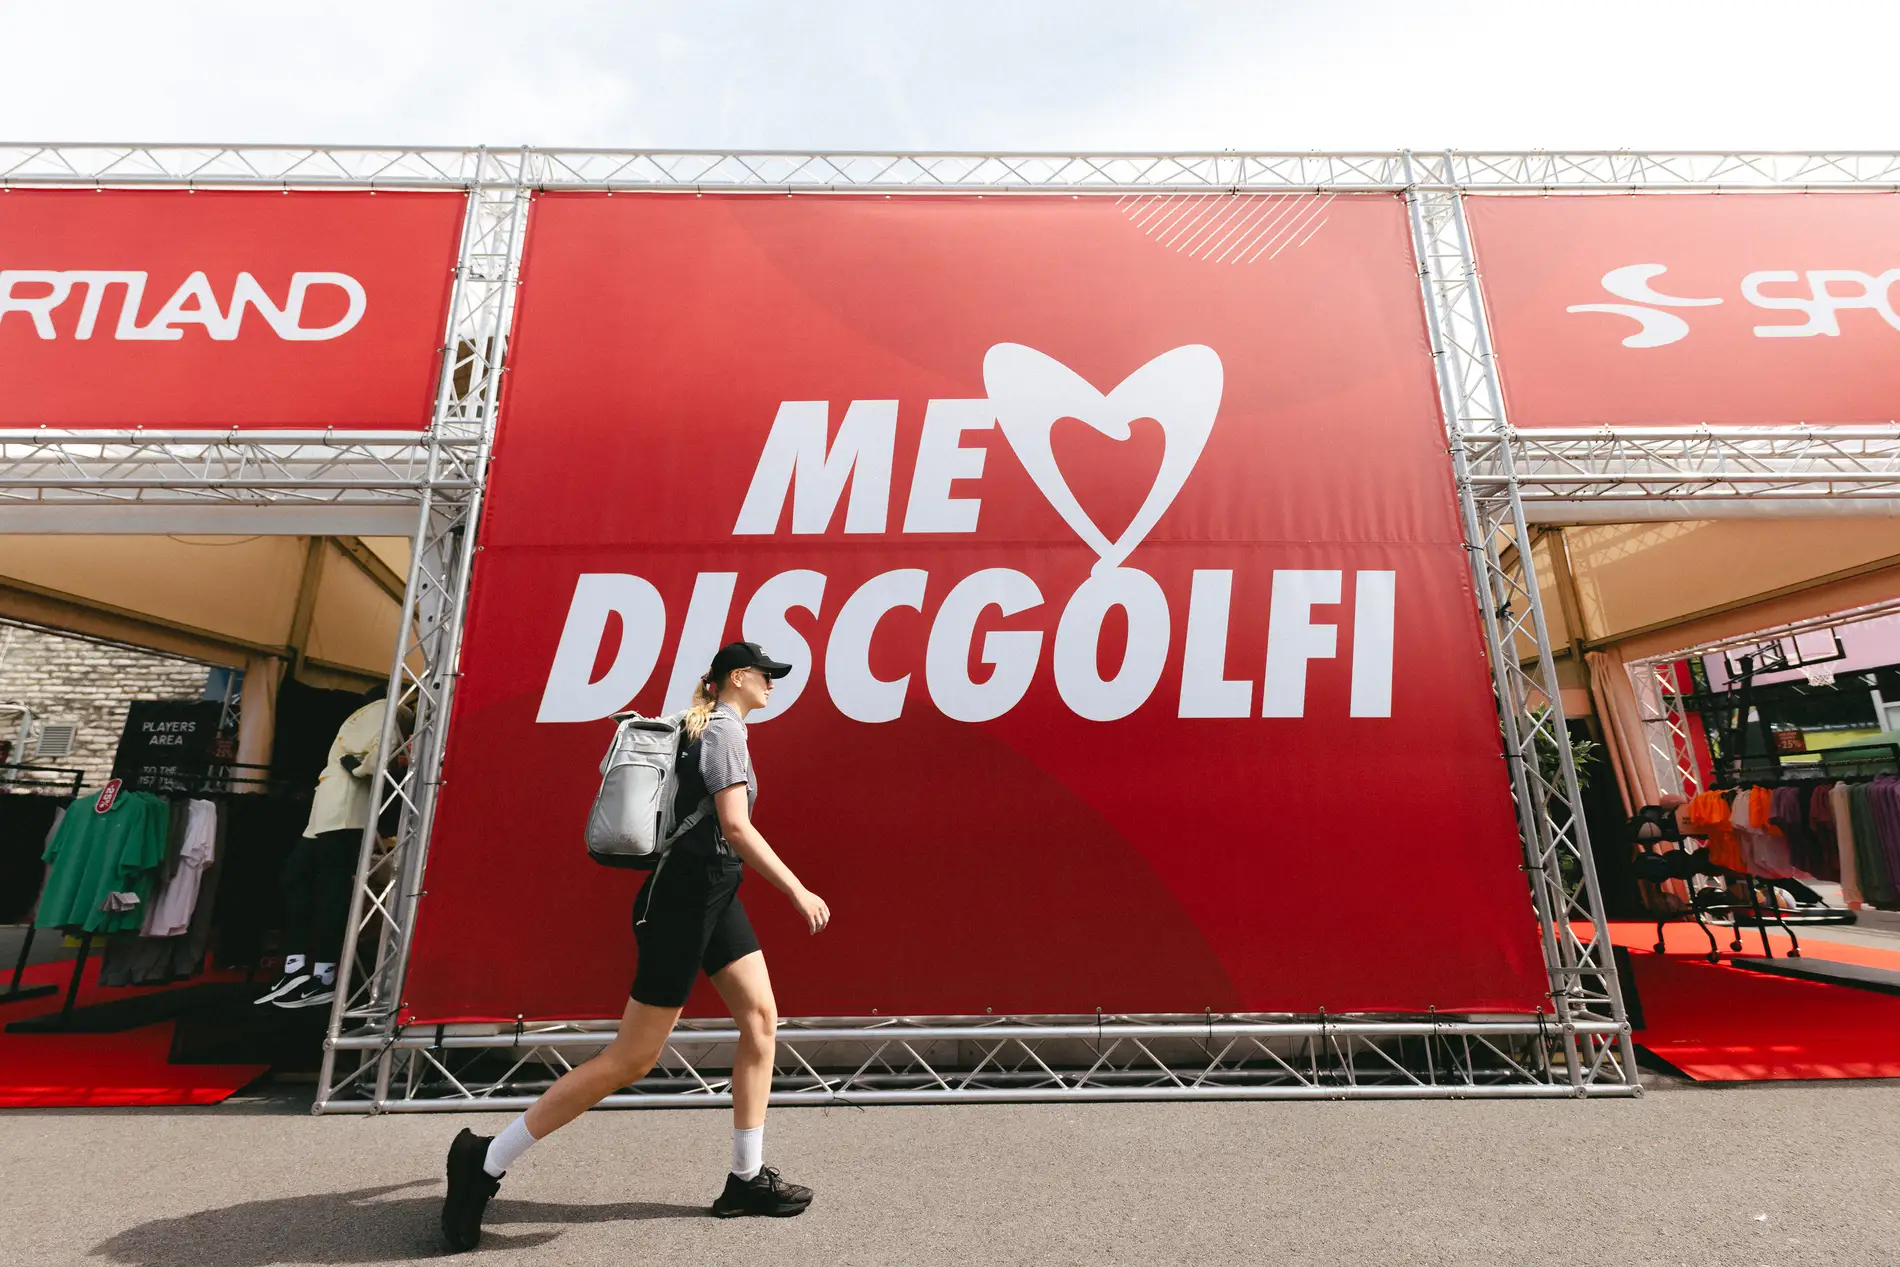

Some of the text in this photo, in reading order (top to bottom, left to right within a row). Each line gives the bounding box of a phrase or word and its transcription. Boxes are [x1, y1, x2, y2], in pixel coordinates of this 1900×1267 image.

[1740, 267, 1900, 337] SP
[732, 399, 994, 535] ME
[535, 567, 1396, 723] DISCGOLFI
[142, 721, 197, 732] PLAYERS
[149, 734, 183, 746] AREA
[99, 784, 116, 808] -25%
